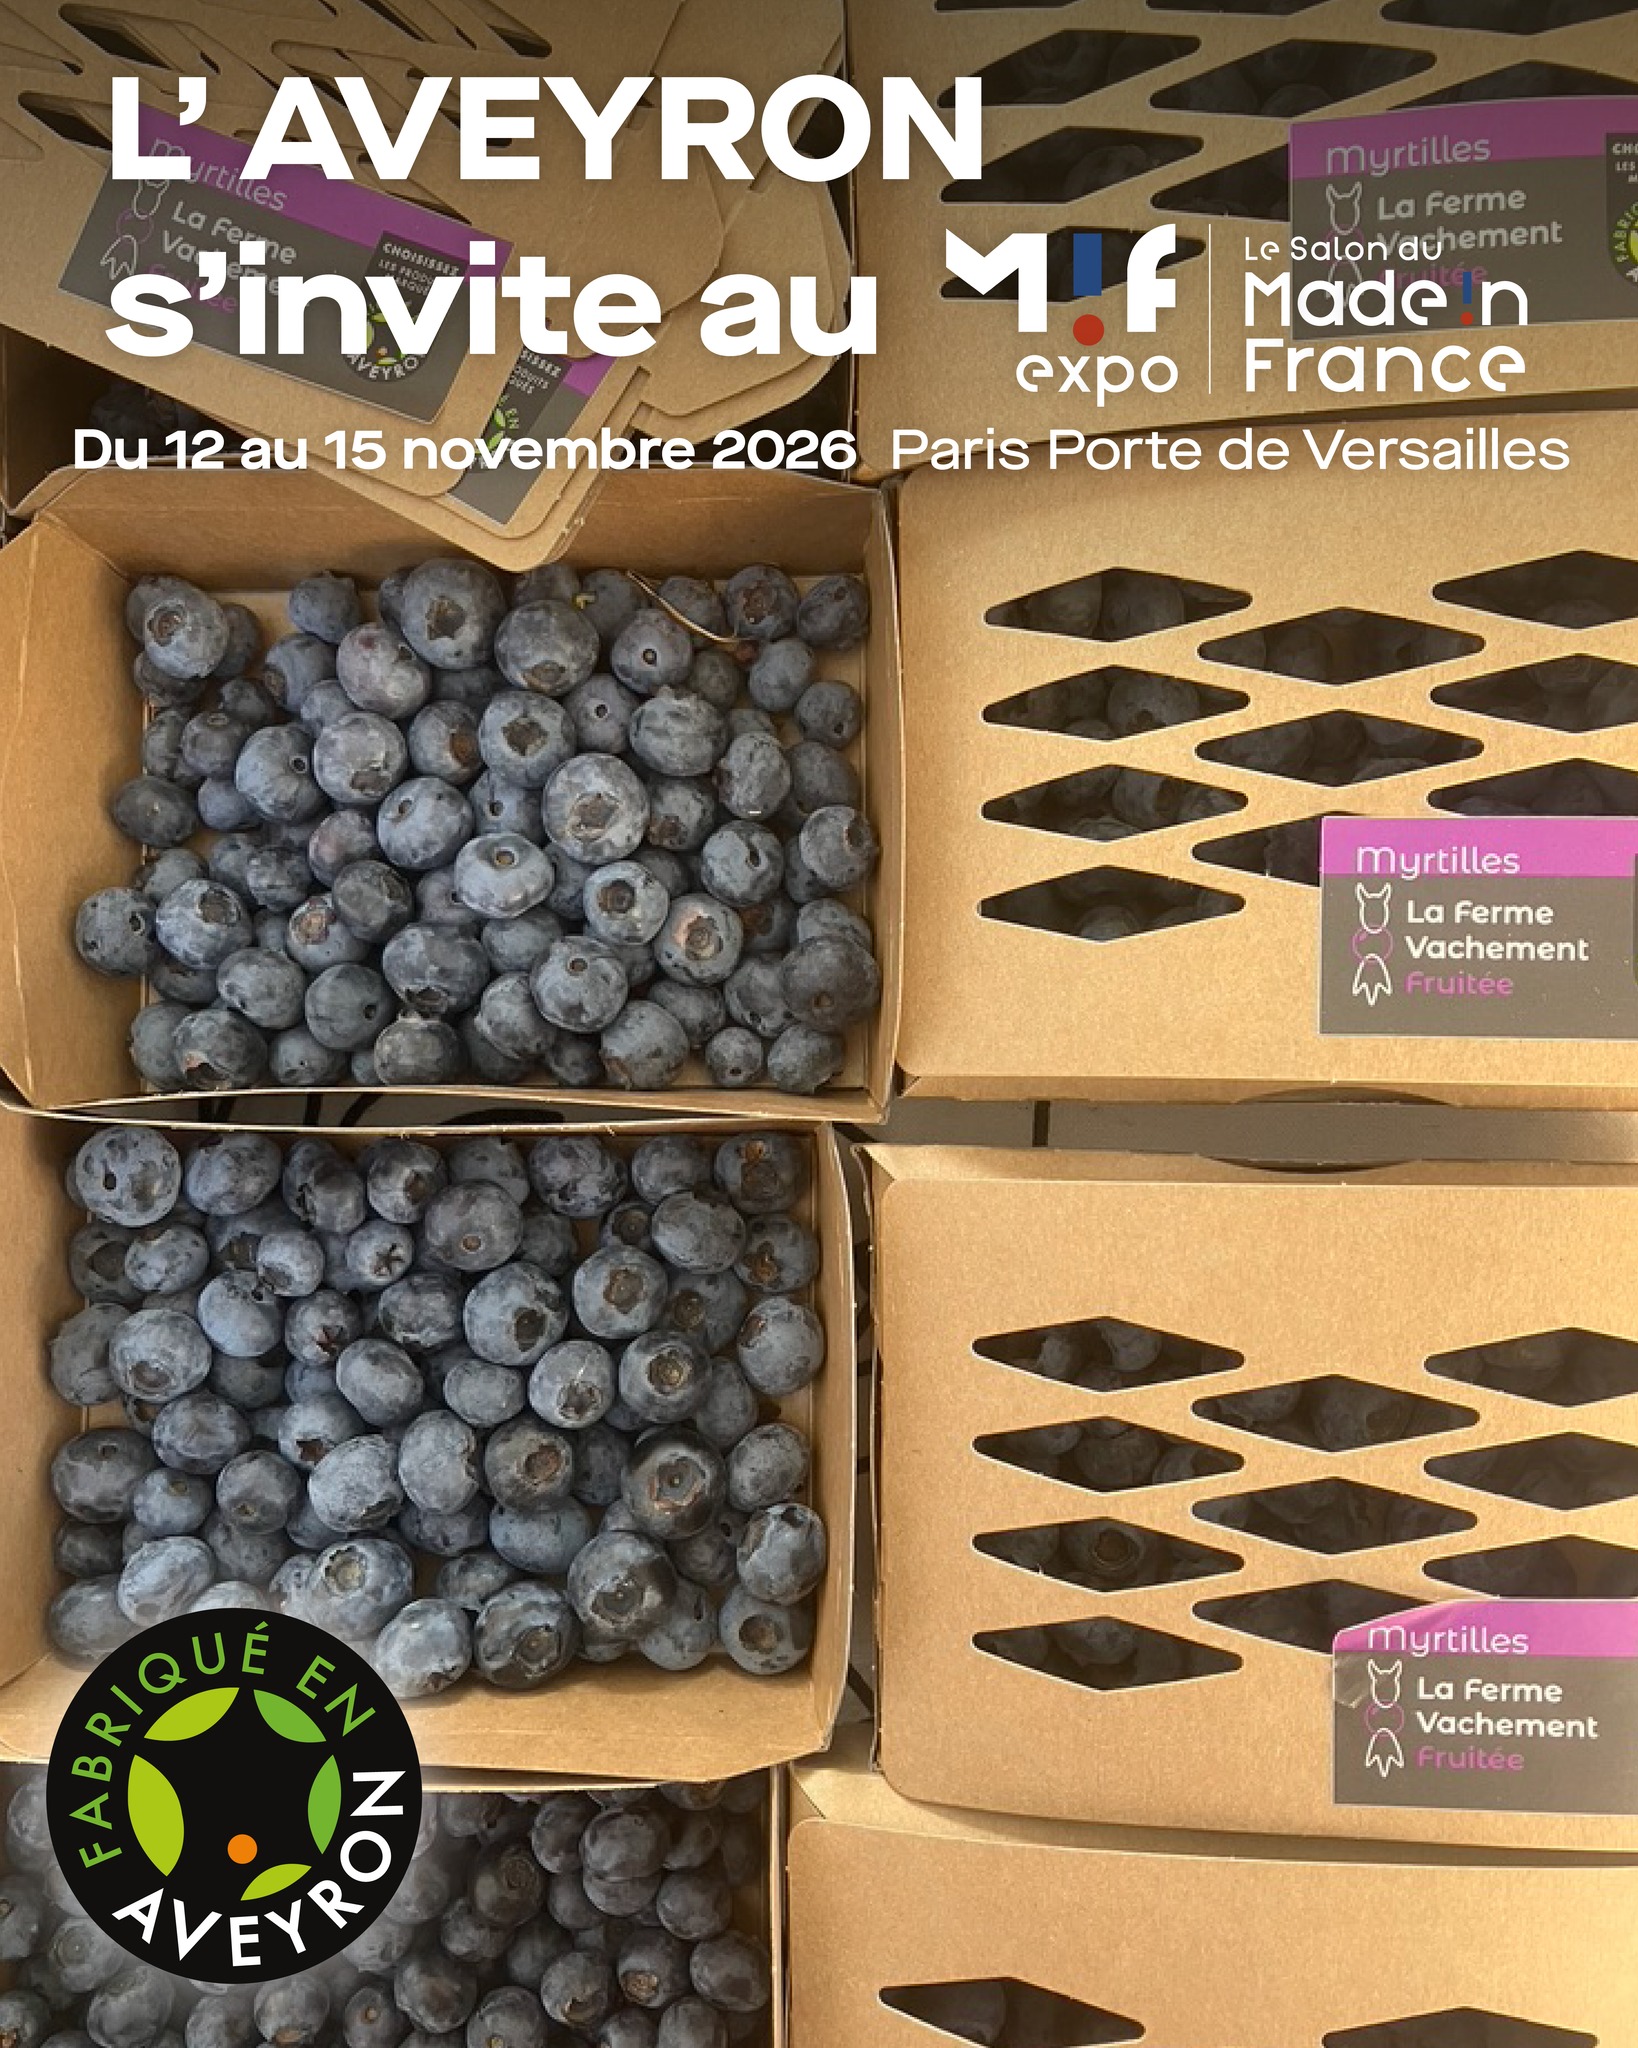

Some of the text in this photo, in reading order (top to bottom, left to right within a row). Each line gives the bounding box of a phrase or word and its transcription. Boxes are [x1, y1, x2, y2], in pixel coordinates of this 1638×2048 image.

[171, 200, 207, 230] La
[1377, 189, 1527, 221] La Ferme
[1407, 900, 1554, 925] La Ferme
[1404, 935, 1590, 961] Vachement
[1405, 970, 1514, 997] Fruitée
[1417, 1676, 1563, 1702] La Ferme
[1415, 1711, 1599, 1739] Vachement
[1416, 1745, 1525, 1771] Fruitée
